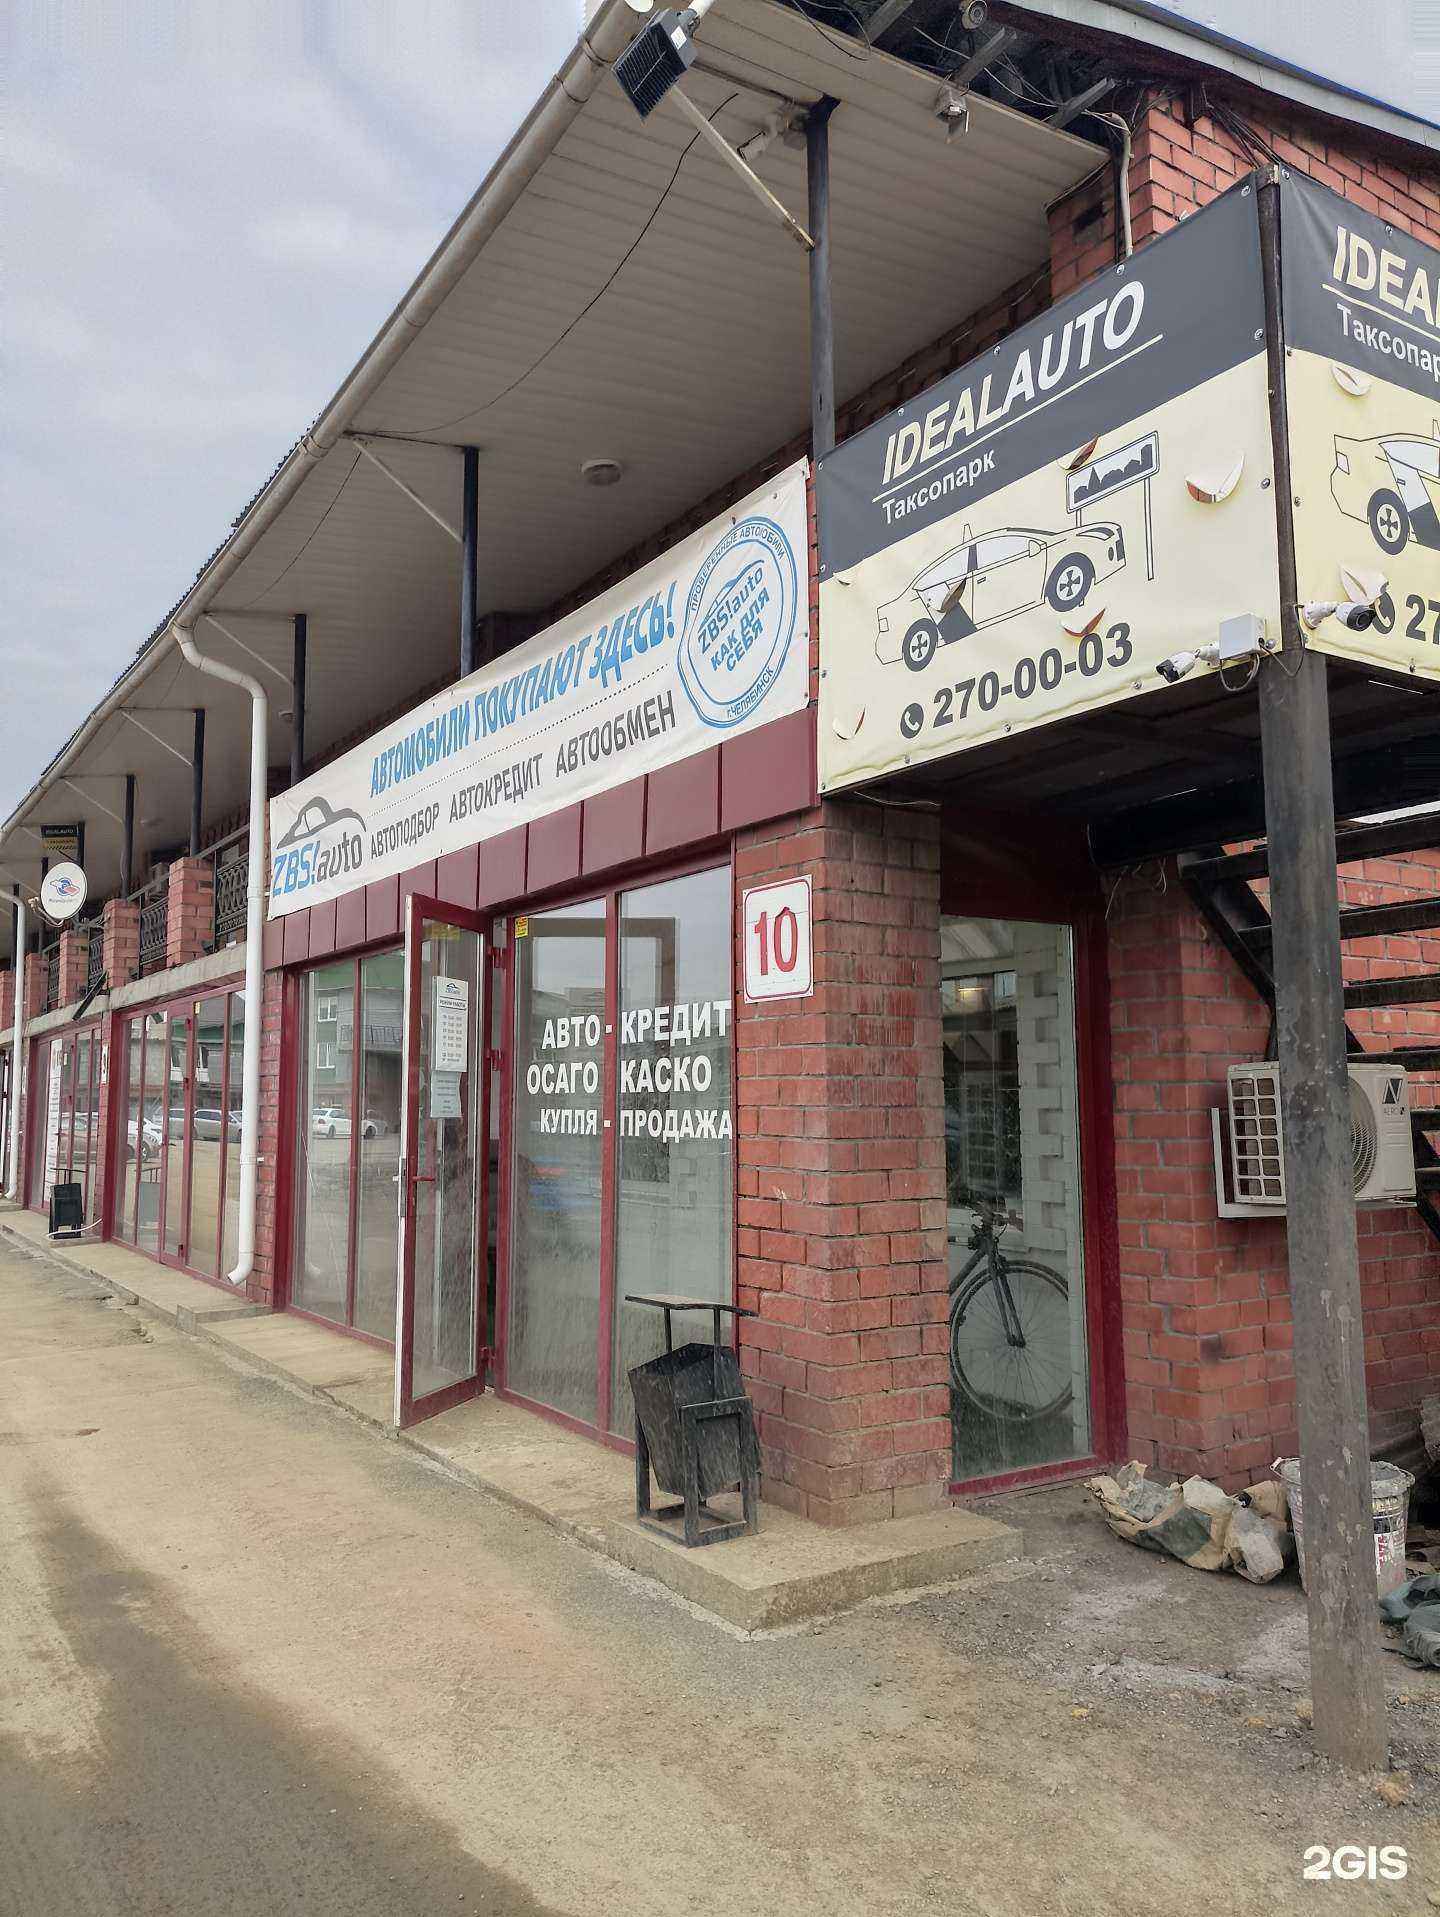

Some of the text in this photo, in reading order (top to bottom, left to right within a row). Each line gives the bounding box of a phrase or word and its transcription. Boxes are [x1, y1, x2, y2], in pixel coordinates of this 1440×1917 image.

[1332, 225, 1440, 329] IDEA
[882, 280, 1145, 485] IDEALAUTO
[882, 450, 996, 524] Таксопарк
[710, 587, 770, 671] КАК ДЛЯ
[726, 617, 764, 672] СЕБЯ
[370, 579, 677, 798] АВТОМОБИЛИ ПОКУПАЮТ ЗДЕСЬ!
[933, 622, 1133, 728] 270-00-03
[371, 690, 677, 859] АВТОПОДБОР АВТОКРЕДИТ АВТООБМЕН
[272, 831, 363, 898] ZBS!auto
[754, 906, 799, 976] 10
[541, 1014, 600, 1050] АВТО
[621, 1000, 732, 1046] КРЕДИТ
[527, 1055, 712, 1095] ОСАГО КАСКО
[540, 1108, 597, 1137] КУПЛЯ
[620, 1109, 732, 1144] ПРОДАЖА
